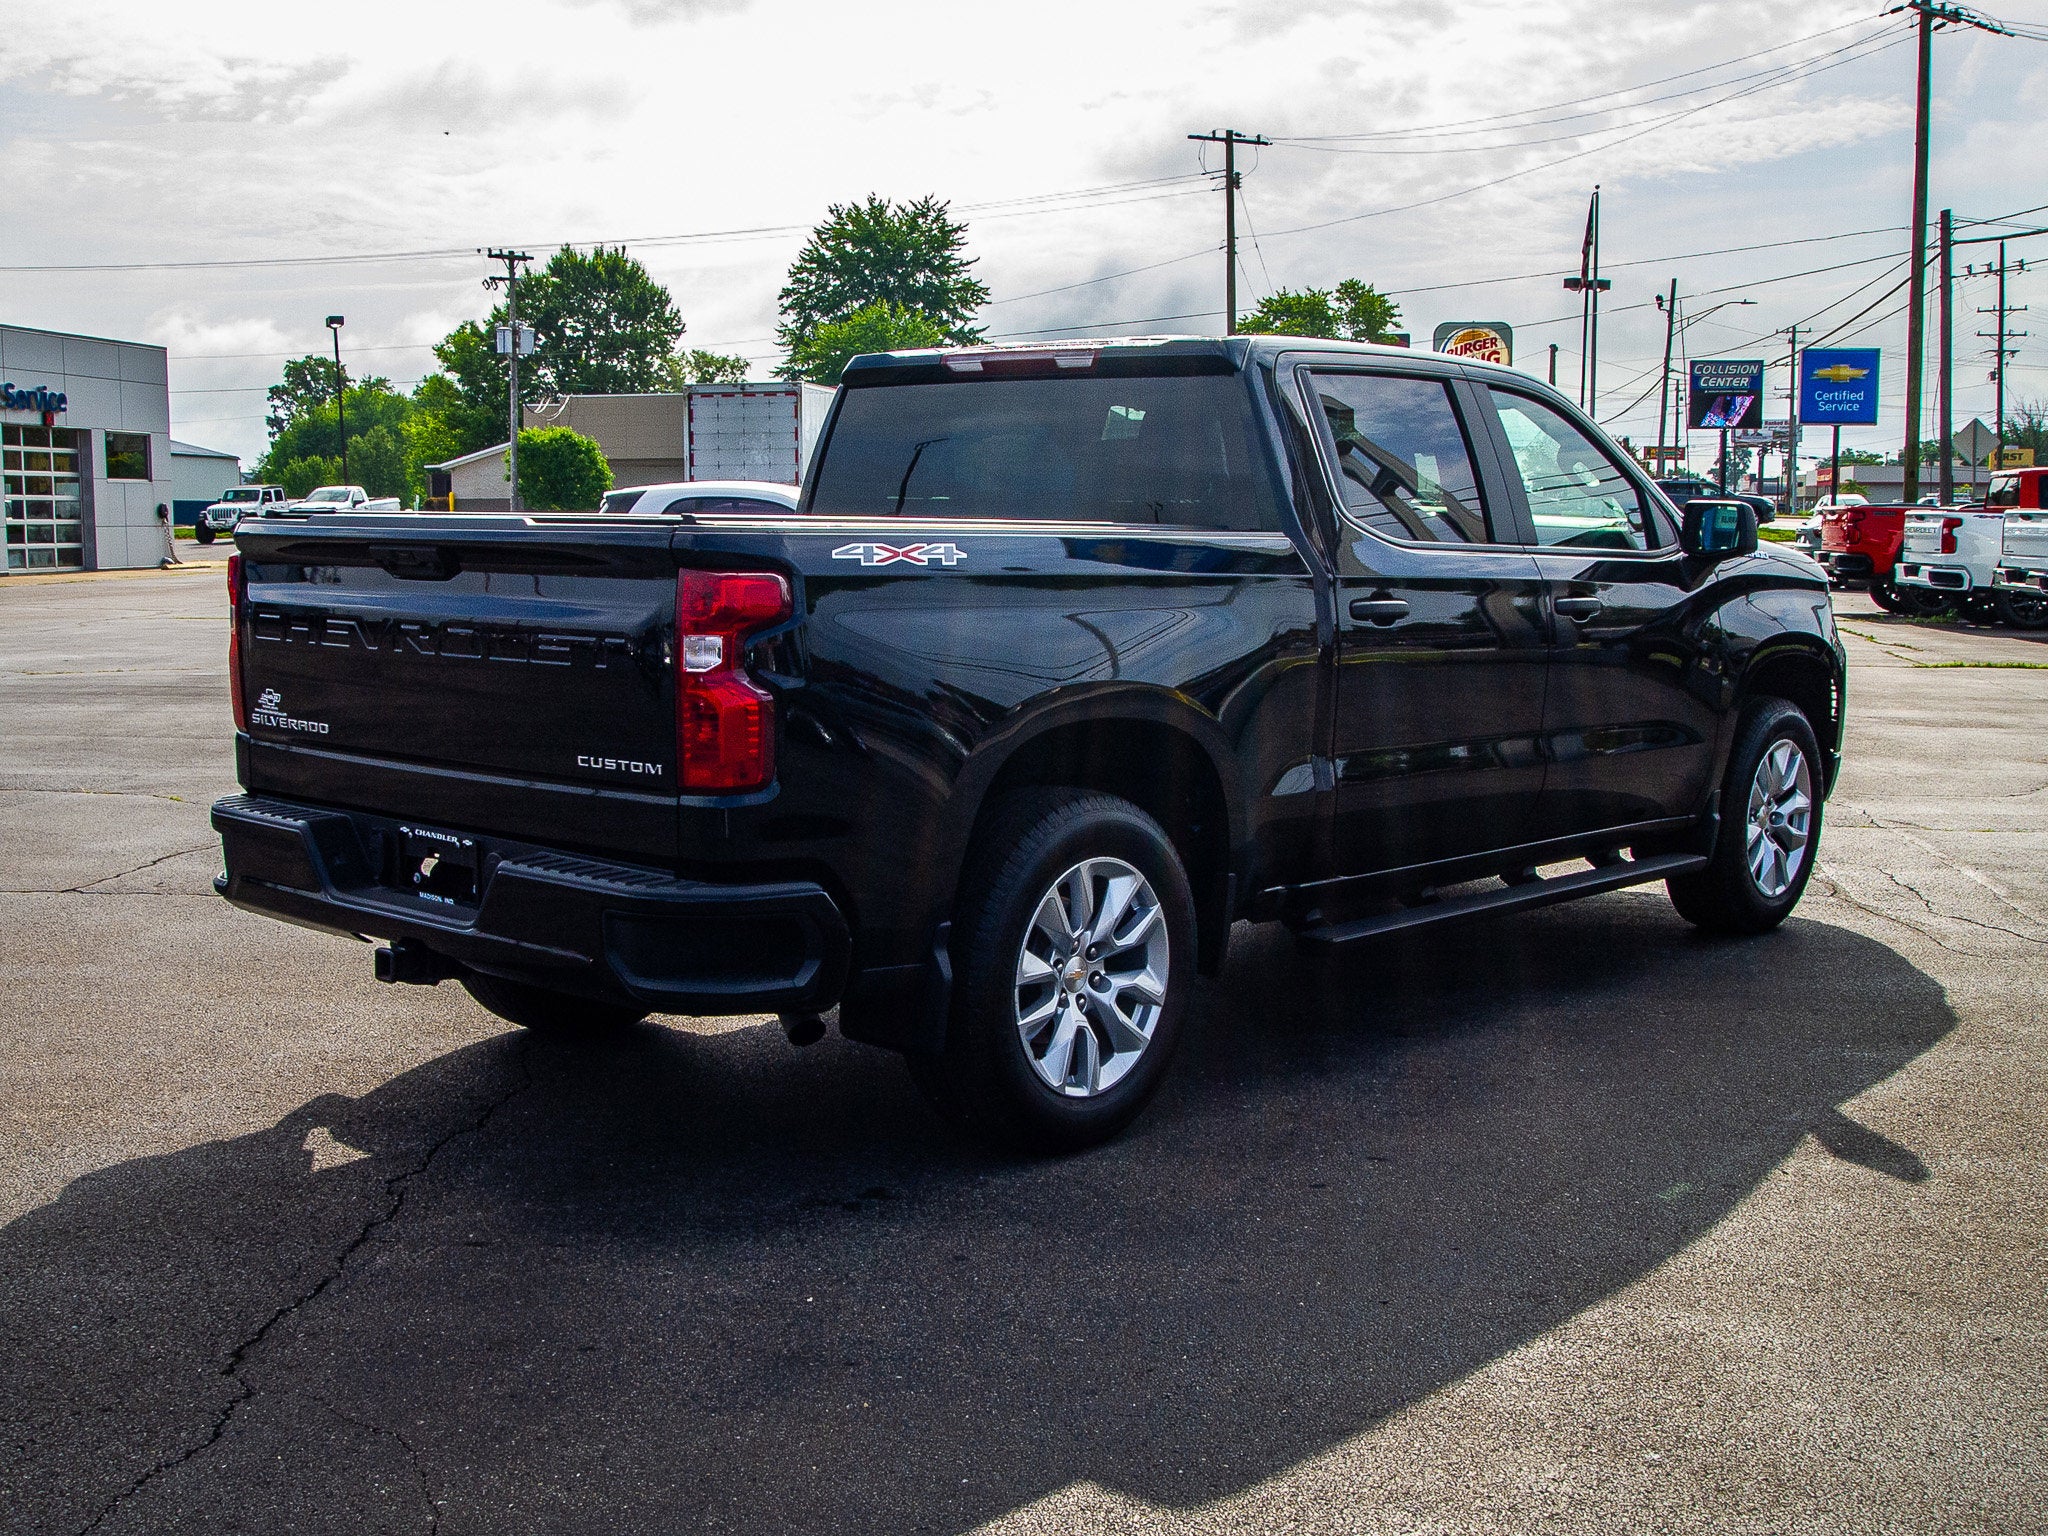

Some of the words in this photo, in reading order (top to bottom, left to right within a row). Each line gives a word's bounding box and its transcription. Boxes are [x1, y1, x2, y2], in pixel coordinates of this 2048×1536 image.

[1694, 364, 1759, 375] COLLISION
[1700, 376, 1750, 387] CENTER
[1814, 390, 1865, 401] Certified
[1817, 401, 1860, 411] Service
[831, 542, 968, 567] 4X4
[254, 612, 626, 668] CHEVROLET
[251, 713, 330, 734] SILVERADO
[577, 755, 663, 775] CUSTOM
[414, 828, 459, 845] CHANDLER
